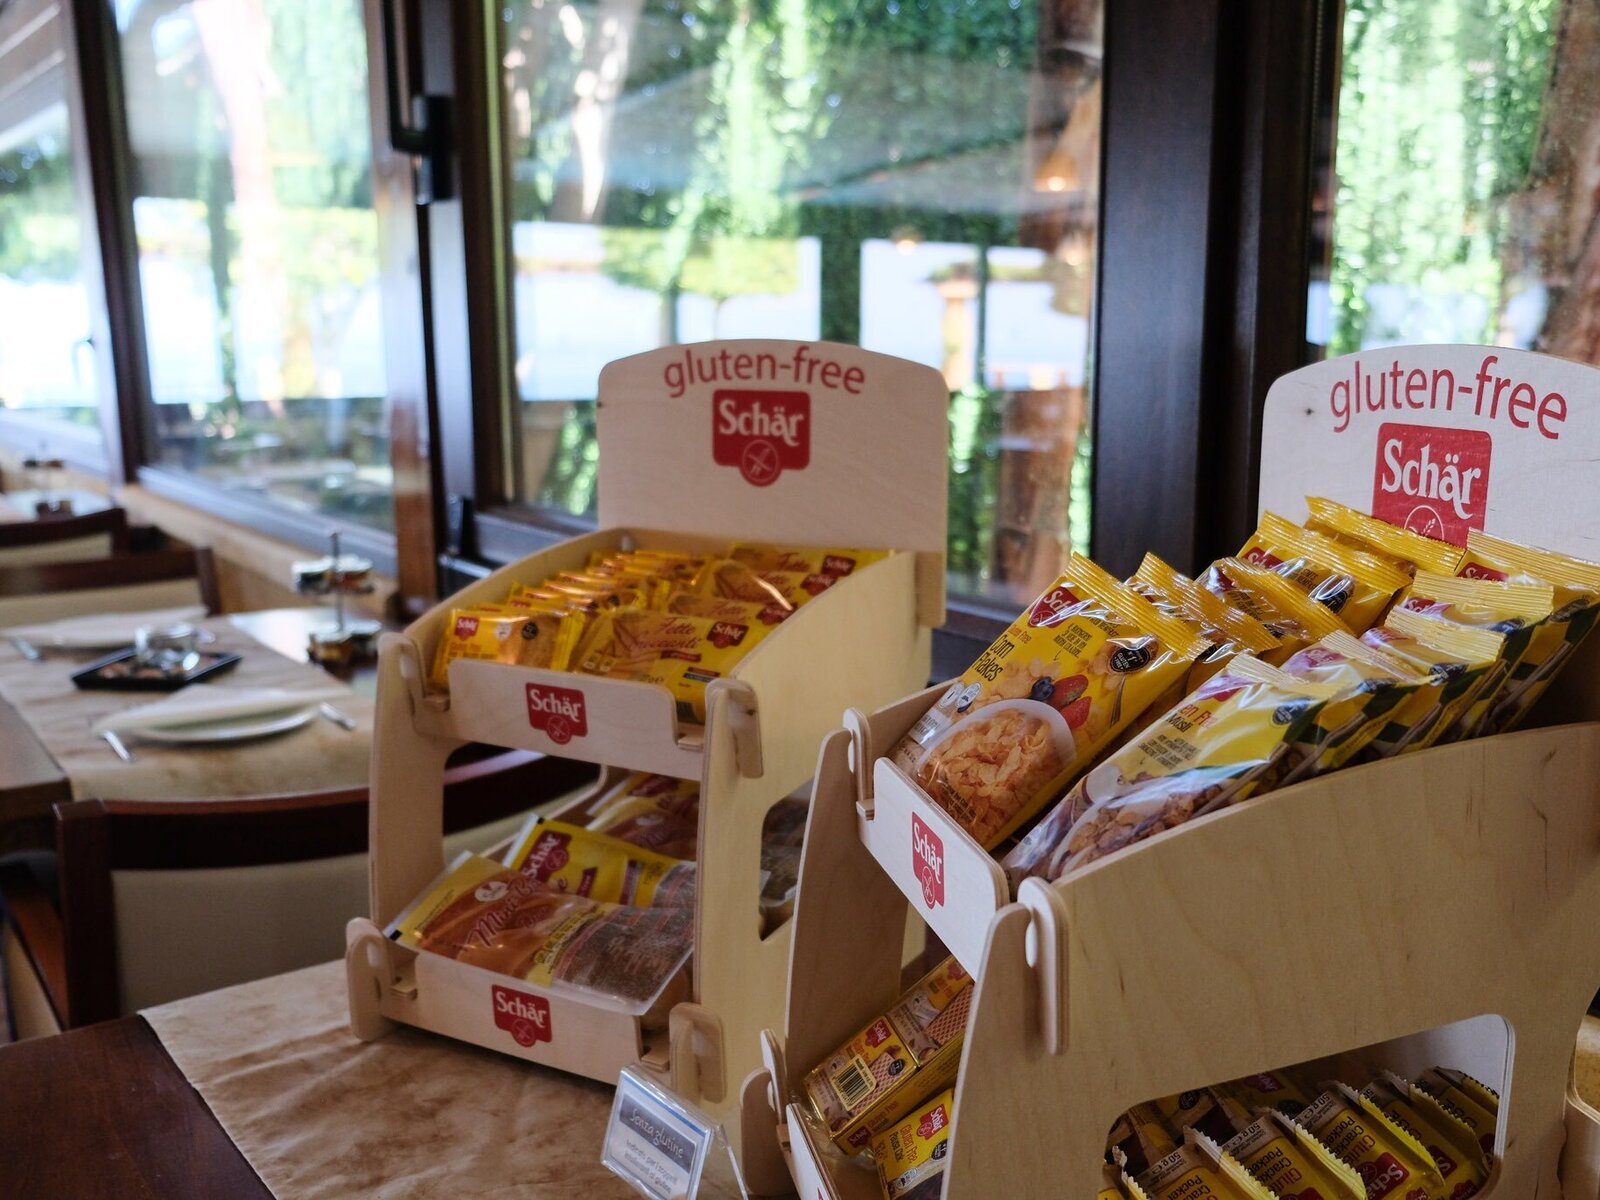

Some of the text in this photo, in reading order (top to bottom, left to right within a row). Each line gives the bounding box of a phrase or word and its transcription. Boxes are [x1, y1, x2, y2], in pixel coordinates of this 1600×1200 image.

[664, 345, 865, 398] gluten-free
[1330, 355, 1568, 440] gluten-free
[718, 399, 804, 447] Schär
[1381, 438, 1482, 520] Schär
[713, 623, 745, 641] Schär
[990, 634, 1015, 659] Corn
[971, 649, 1004, 682] Flakes
[529, 688, 582, 723] Schär
[913, 821, 943, 885] Schär
[495, 990, 547, 1028] Schär
[630, 1108, 684, 1159] Senza glutine
[930, 1106, 945, 1134] Schär
[1332, 1125, 1365, 1156] Cracke
[1343, 1134, 1377, 1163] Glute
[1369, 1163, 1404, 1200] Sch
